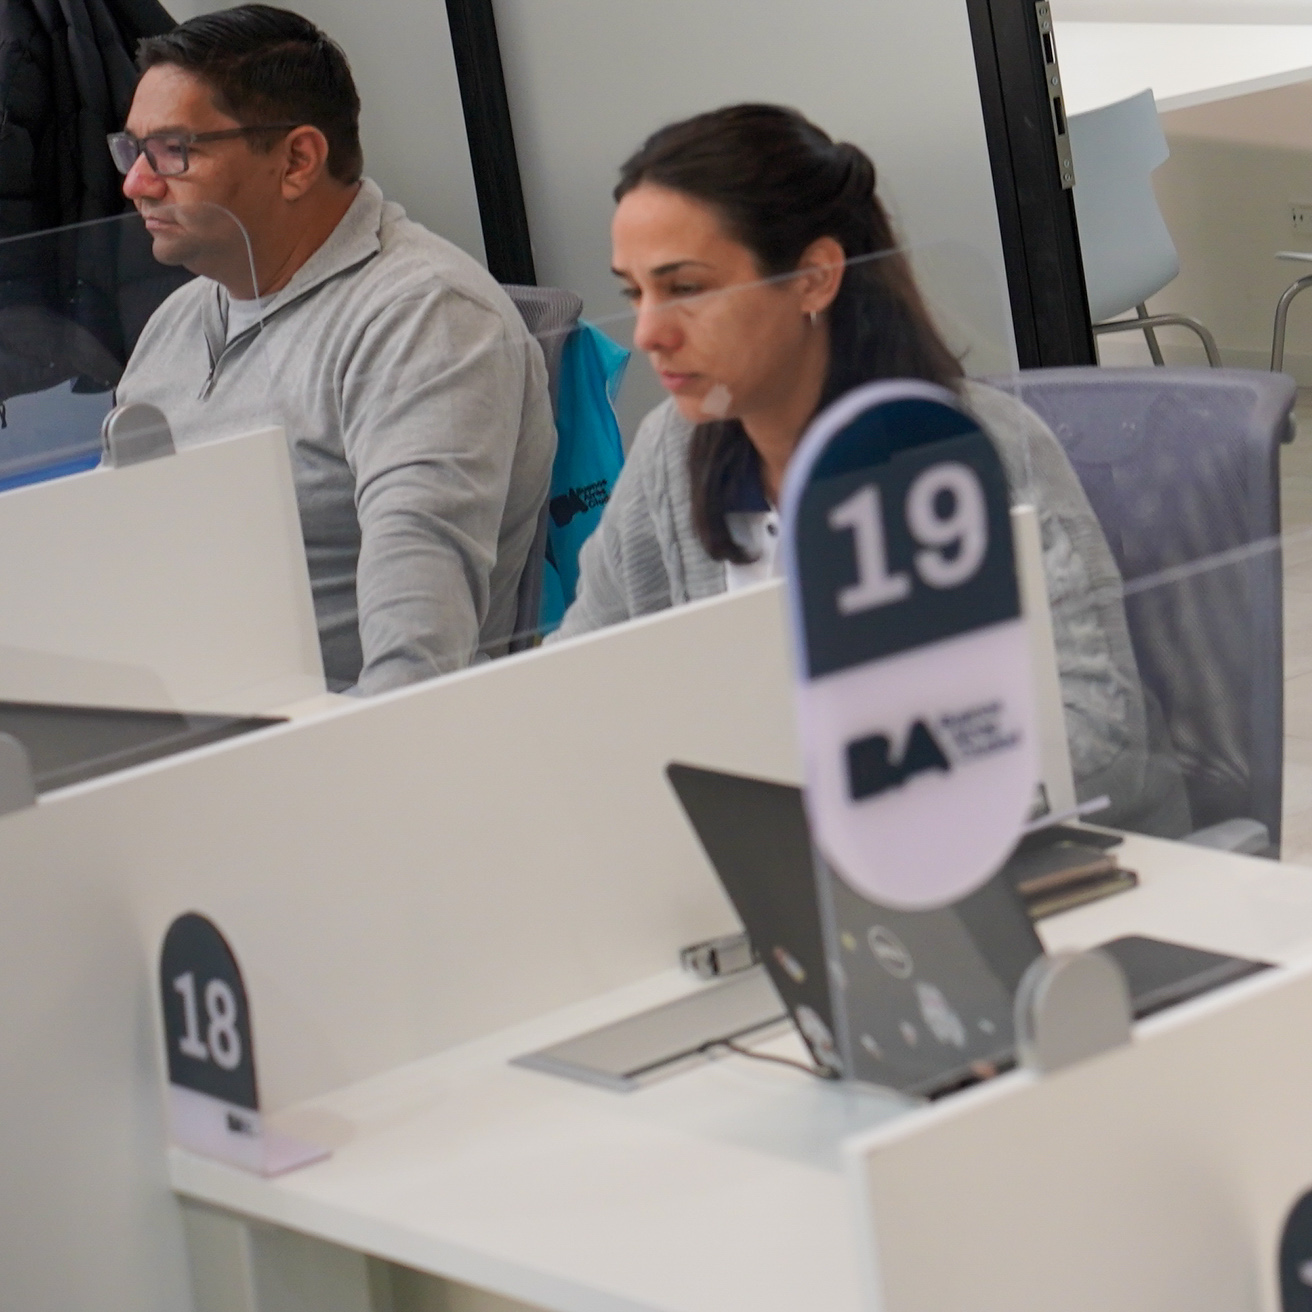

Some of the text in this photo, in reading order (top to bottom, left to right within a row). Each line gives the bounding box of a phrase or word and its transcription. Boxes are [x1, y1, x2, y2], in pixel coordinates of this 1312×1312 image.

[828, 461, 988, 616] 19
[844, 717, 952, 804] BA
[173, 971, 241, 1070] 18
